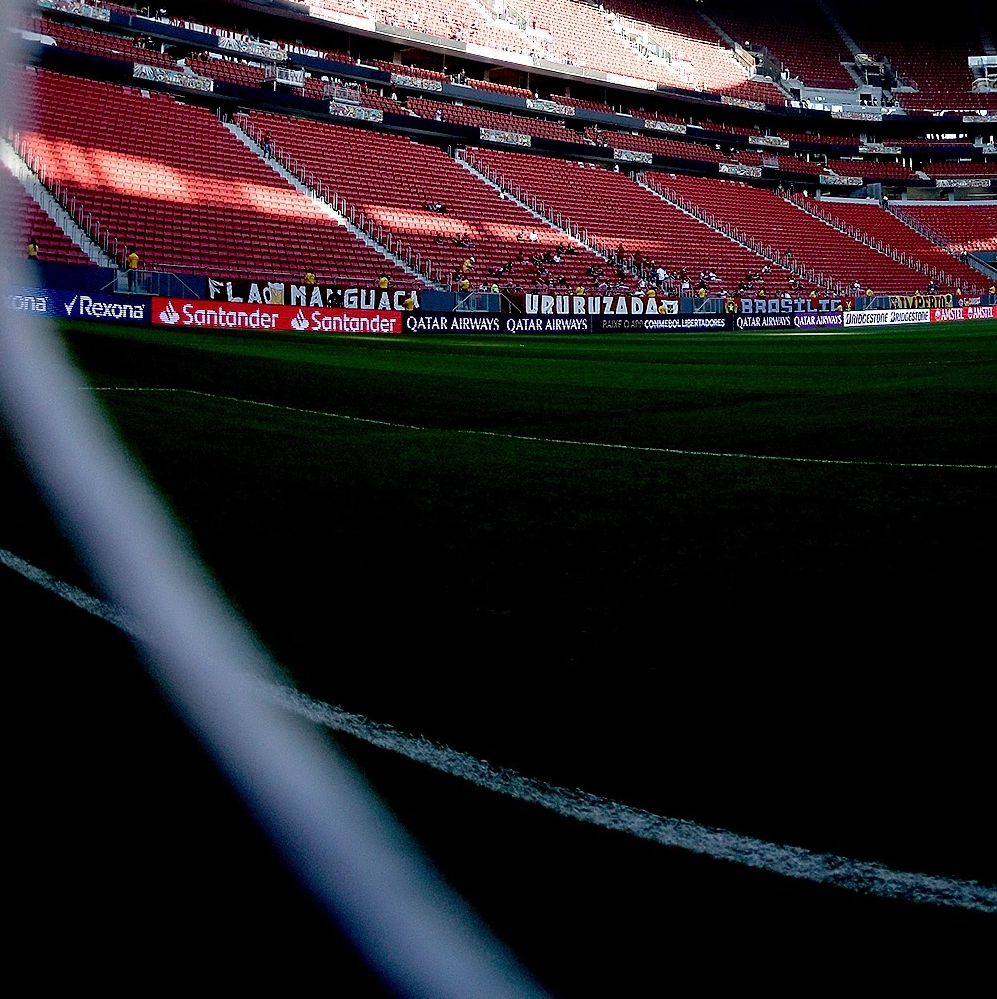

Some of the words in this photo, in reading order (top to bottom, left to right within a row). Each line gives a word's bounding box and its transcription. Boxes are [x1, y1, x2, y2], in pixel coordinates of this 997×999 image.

[80, 295, 146, 319] Rexona
[525, 293, 659, 315] URUBUZADA
[182, 303, 279, 329] Santander
[941, 308, 965, 321] AMSTEL
[973, 306, 994, 319] AMSTEL
[311, 311, 397, 333] Santander
[406, 316, 448, 333] QATAR
[450, 317, 500, 331] AIRWAYS
[506, 318, 543, 334] QATAR
[545, 318, 588, 332] AIRWAYS
[736, 316, 761, 329] QATAR
[762, 315, 791, 327] AIRWAYS
[793, 315, 815, 328] QATAR
[815, 314, 843, 325] AIRWAYS
